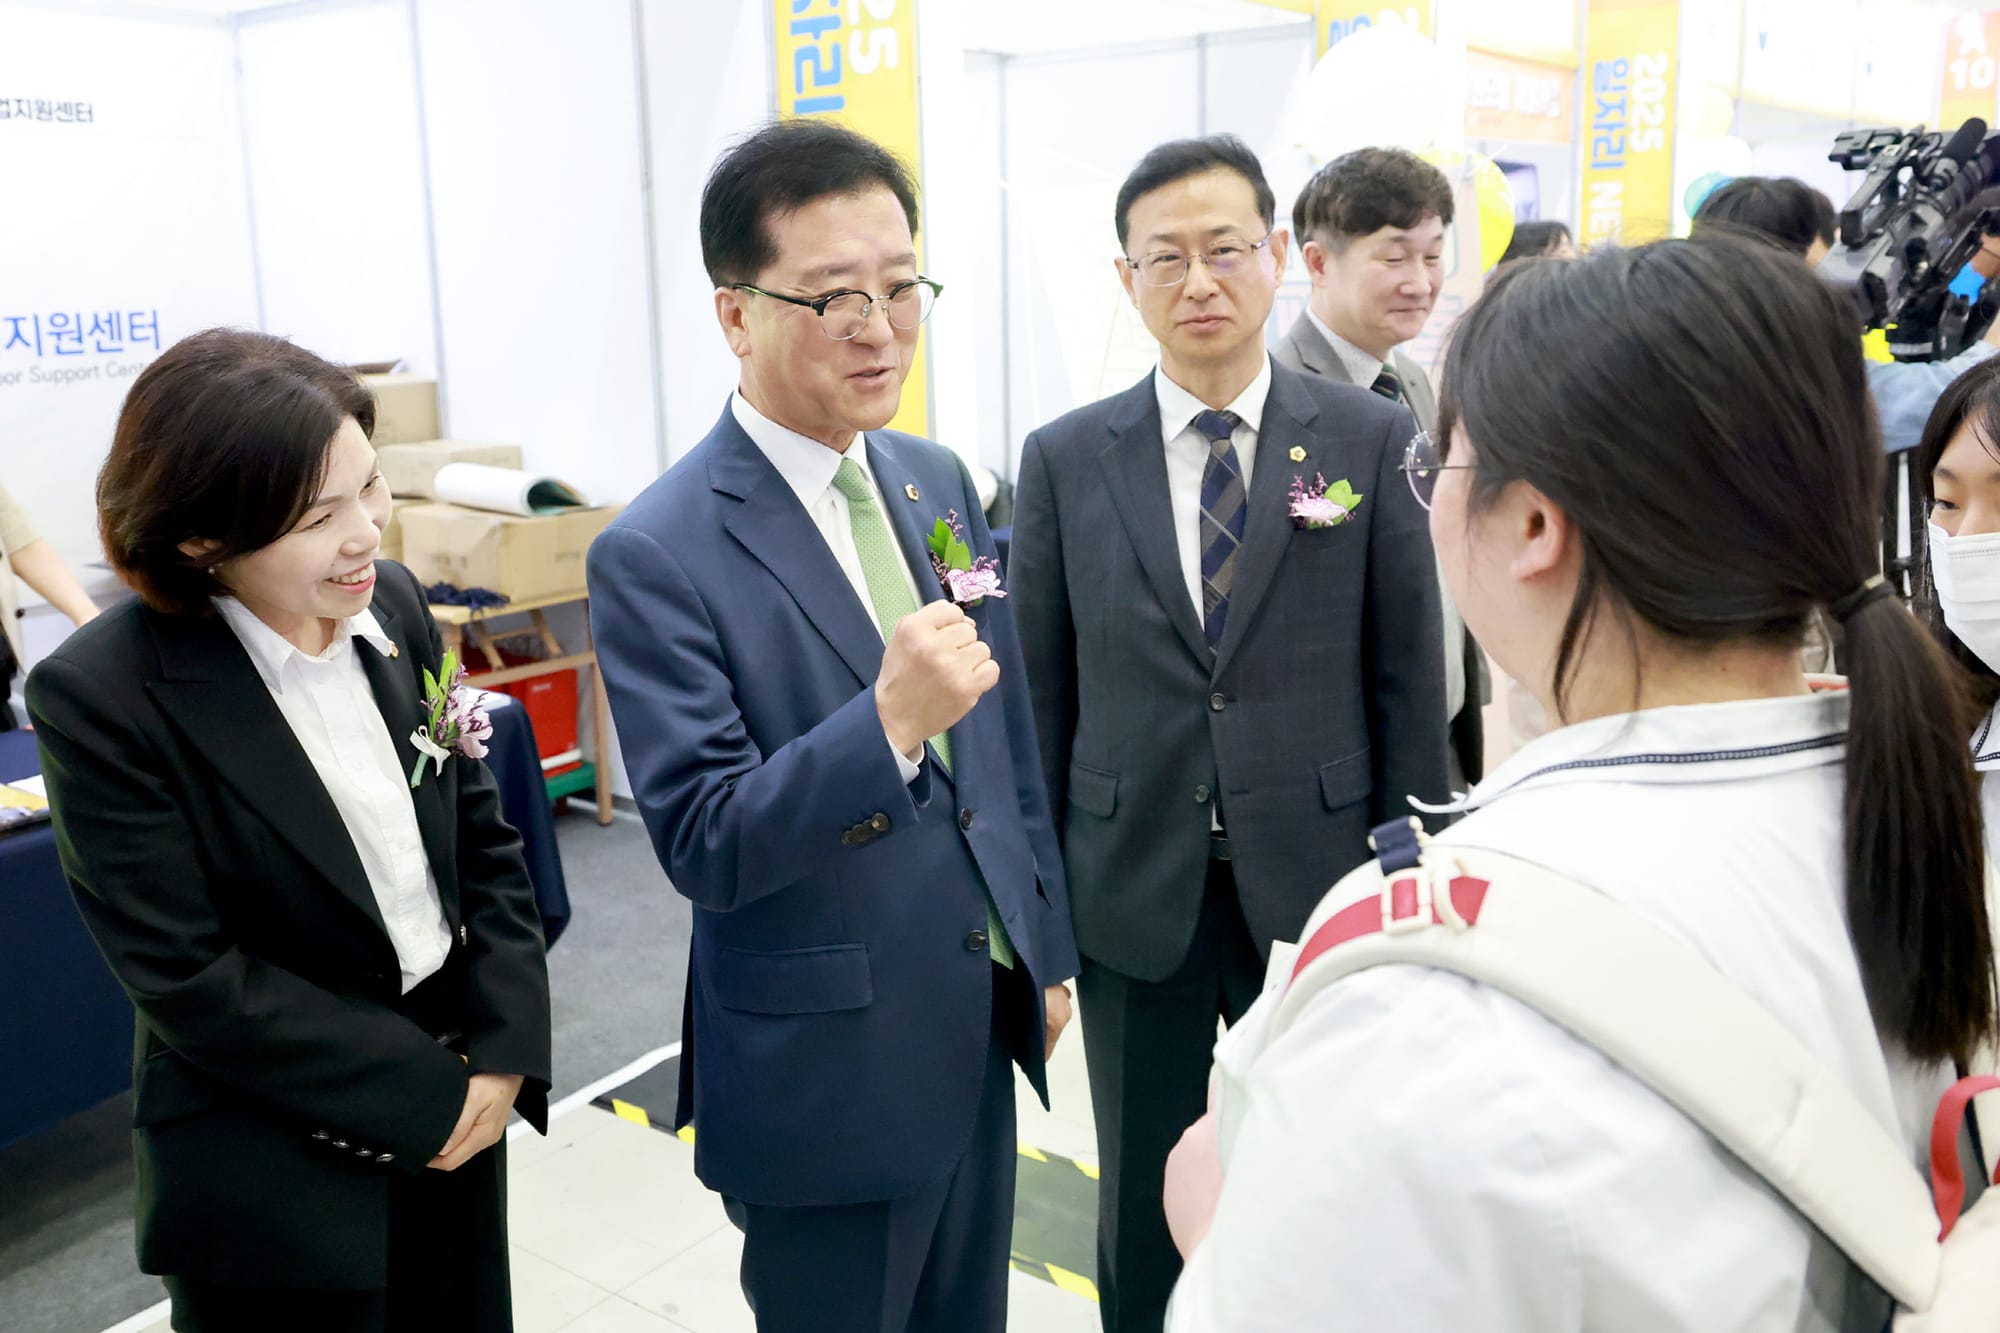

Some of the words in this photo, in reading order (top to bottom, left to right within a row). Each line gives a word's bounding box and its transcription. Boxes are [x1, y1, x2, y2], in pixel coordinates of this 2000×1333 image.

[789, 0, 845, 115] 자리
[848, 0, 899, 75] 25
[1958, 11, 1988, 55] A
[1630, 52, 1669, 153] 2025
[1949, 56, 1996, 91] 10
[1590, 57, 1630, 170] 일자리
[3, 309, 161, 358] 지원센터
[29, 364, 100, 385] Support
